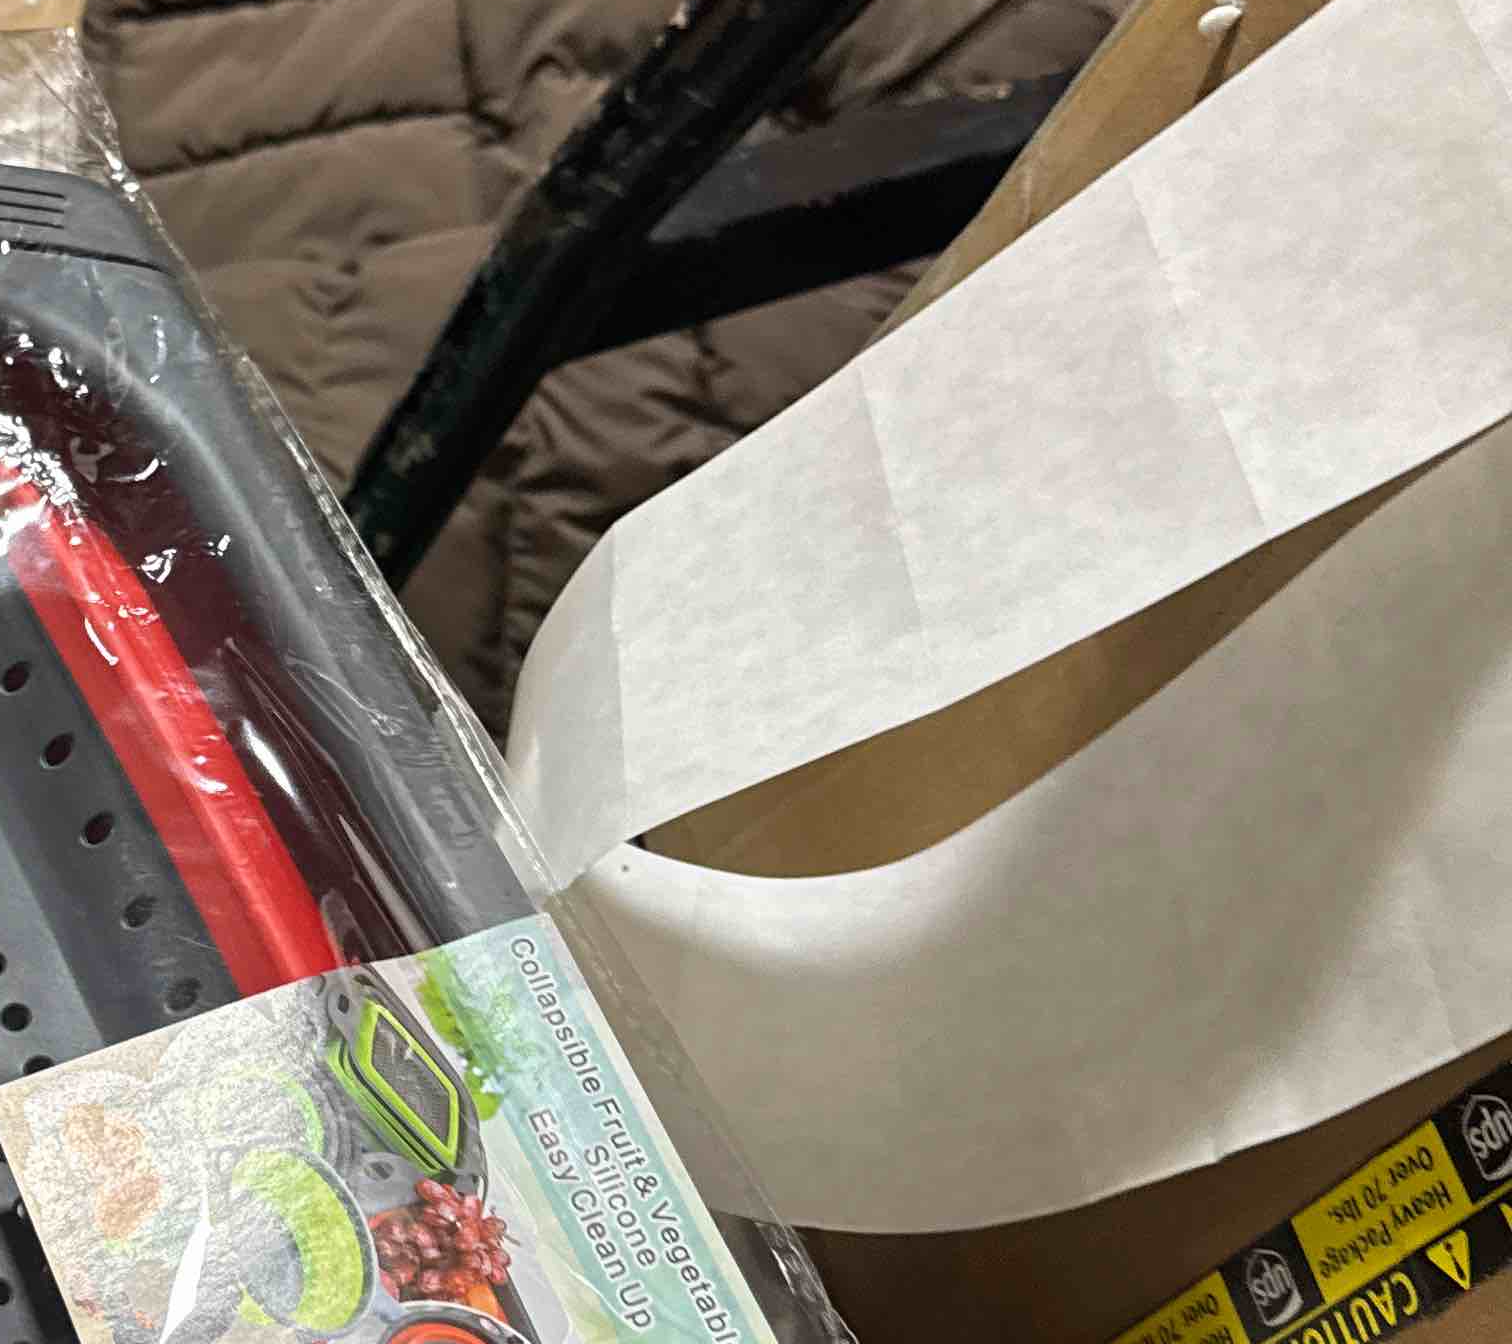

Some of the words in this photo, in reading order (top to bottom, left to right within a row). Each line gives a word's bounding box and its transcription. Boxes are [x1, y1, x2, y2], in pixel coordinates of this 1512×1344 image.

[510, 937, 601, 1094] Collapsible
[593, 1097, 646, 1171] Fruit
[632, 1174, 658, 1199] &
[1386, 1145, 1434, 1187] Over
[584, 1144, 656, 1268] Silicone
[1328, 1196, 1363, 1225] lbs.
[1361, 1177, 1387, 1210] 70
[1391, 1180, 1453, 1229] Heavy
[528, 1108, 580, 1185] Easy
[570, 1189, 628, 1280] Clean
[618, 1282, 653, 1330] Up
[1318, 1220, 1393, 1280] Package
[1250, 1257, 1291, 1307] ups
[1181, 1293, 1220, 1326] Over
